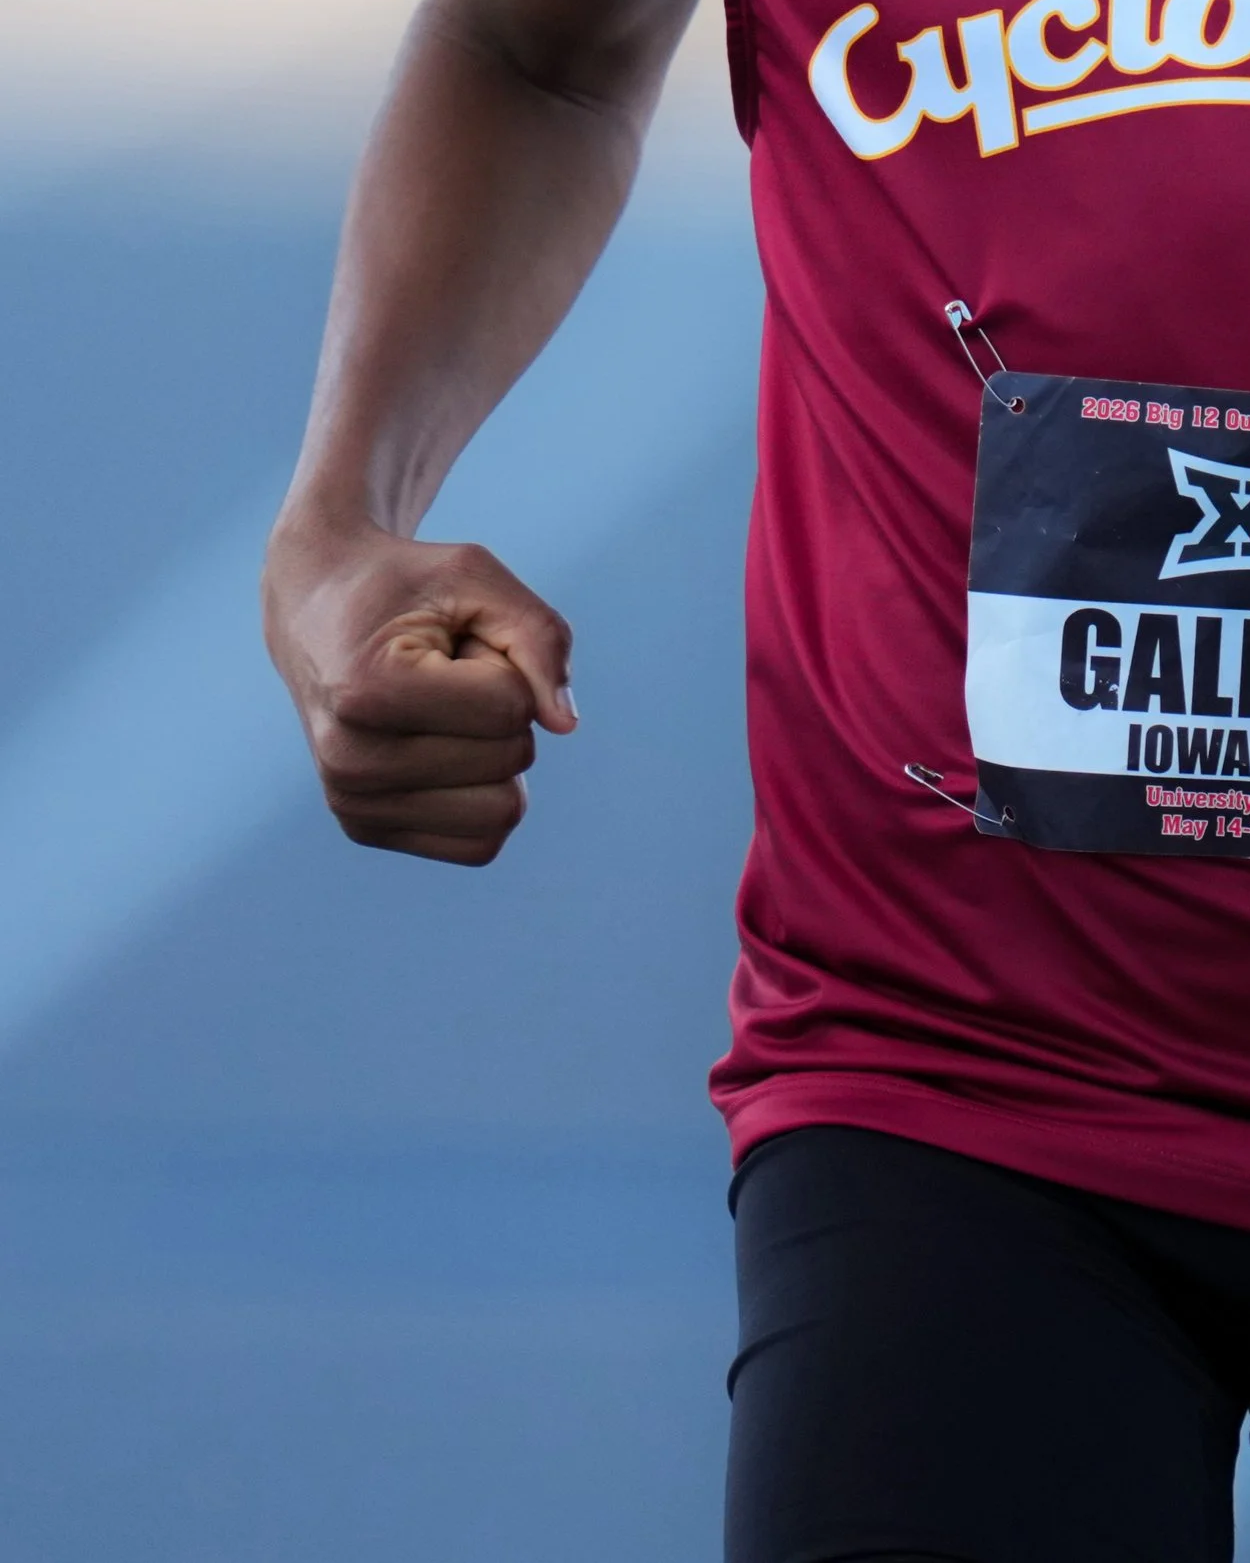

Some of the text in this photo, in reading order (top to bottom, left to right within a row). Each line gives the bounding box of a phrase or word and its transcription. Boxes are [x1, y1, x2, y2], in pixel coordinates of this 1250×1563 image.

[1081, 396, 1141, 422] 2026
[1146, 401, 1185, 430] Big
[1191, 405, 1220, 428] 12
[1161, 814, 1208, 841] May
